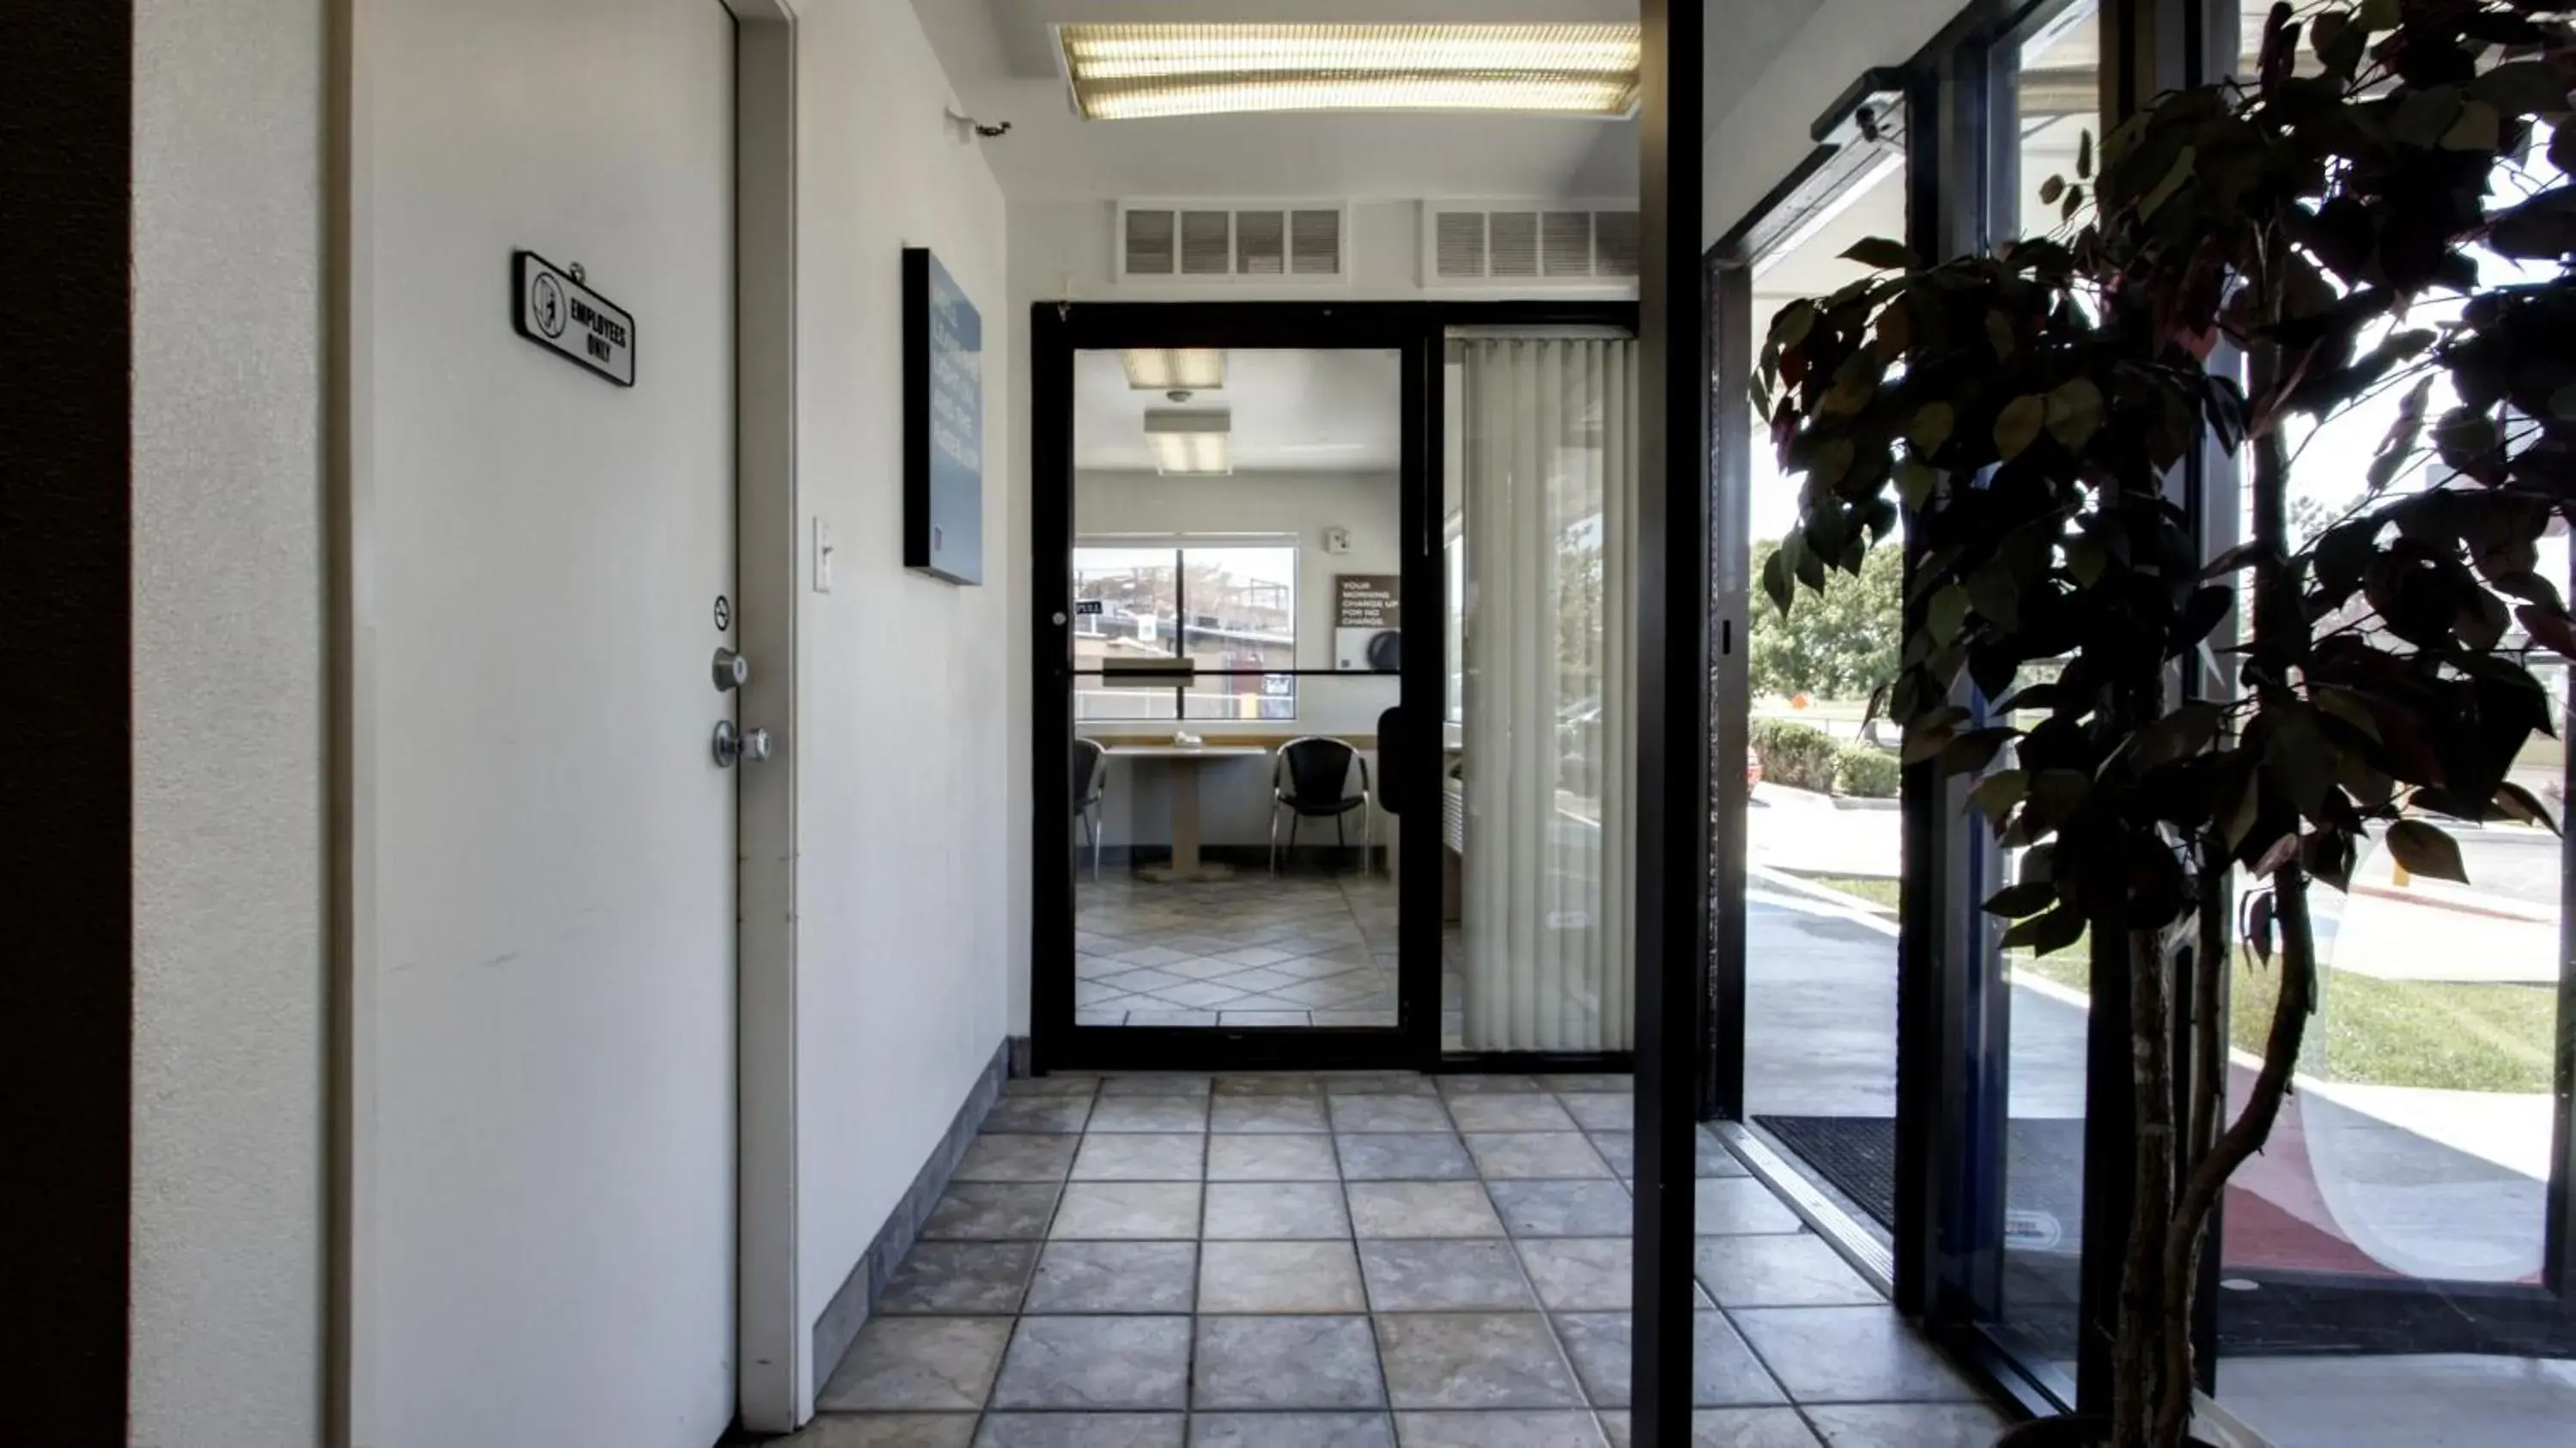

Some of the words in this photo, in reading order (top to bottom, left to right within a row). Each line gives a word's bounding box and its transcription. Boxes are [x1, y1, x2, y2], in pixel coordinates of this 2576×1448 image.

[571, 296, 625, 348] EMPLOYEES
[587, 332, 611, 362] ONLY
[1343, 581, 1370, 590] YOUR
